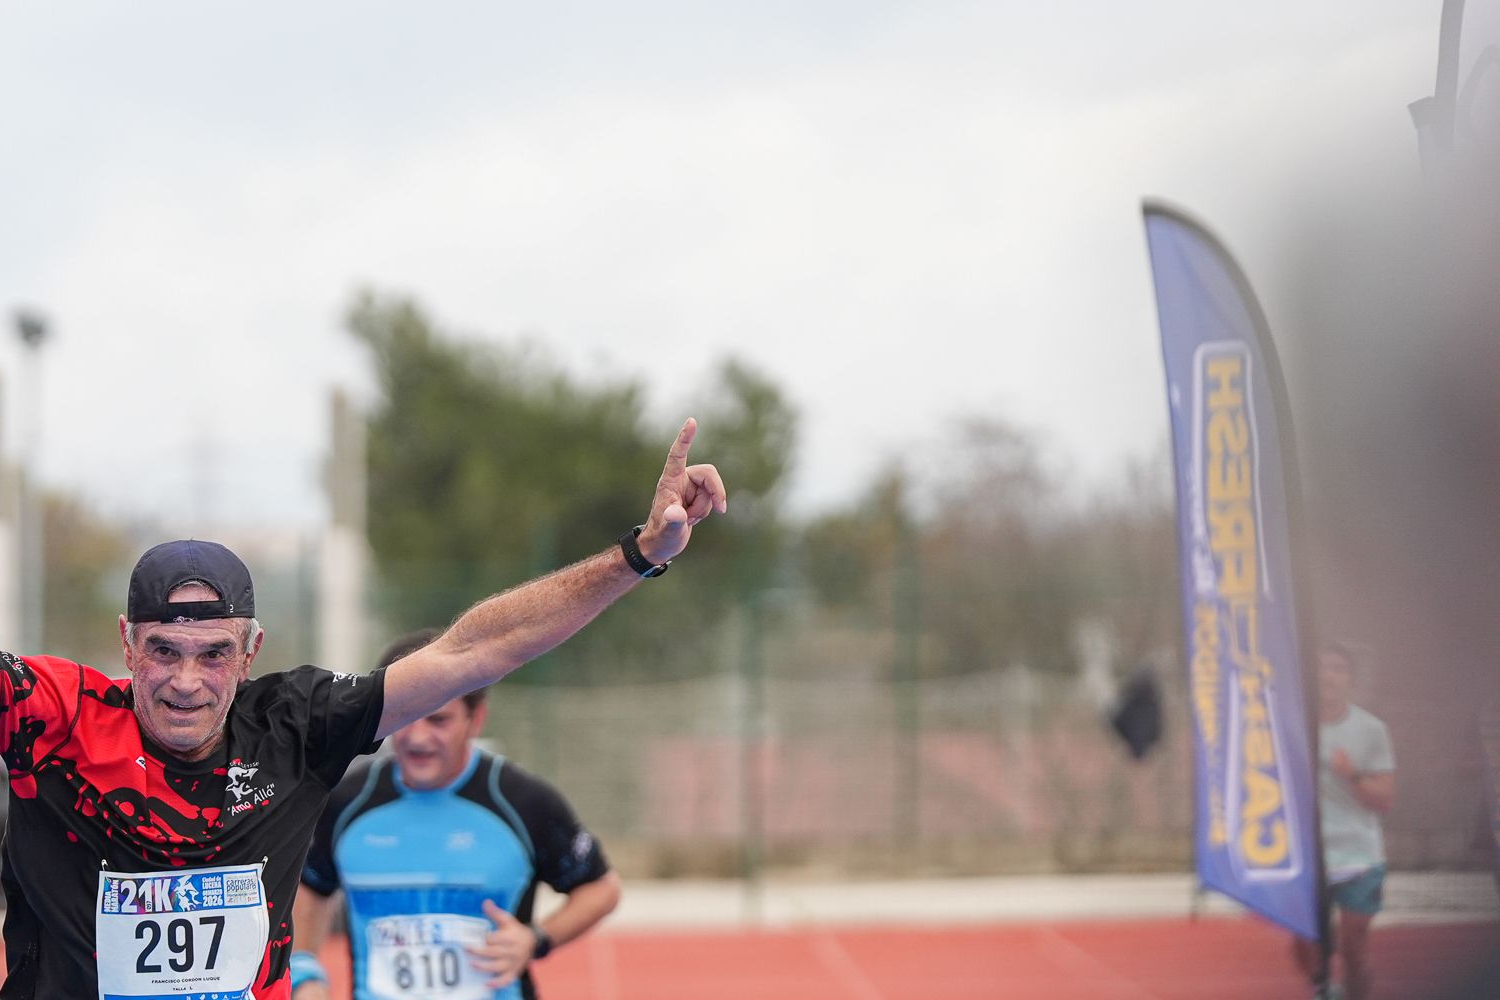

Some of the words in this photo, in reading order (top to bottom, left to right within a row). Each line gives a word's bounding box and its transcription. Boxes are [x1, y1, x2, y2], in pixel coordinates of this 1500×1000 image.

[120, 879, 174, 914] 21K
[226, 878, 254, 886] carreras
[202, 895, 223, 908] 2026
[135, 916, 225, 974] 297
[394, 947, 461, 990] 810
